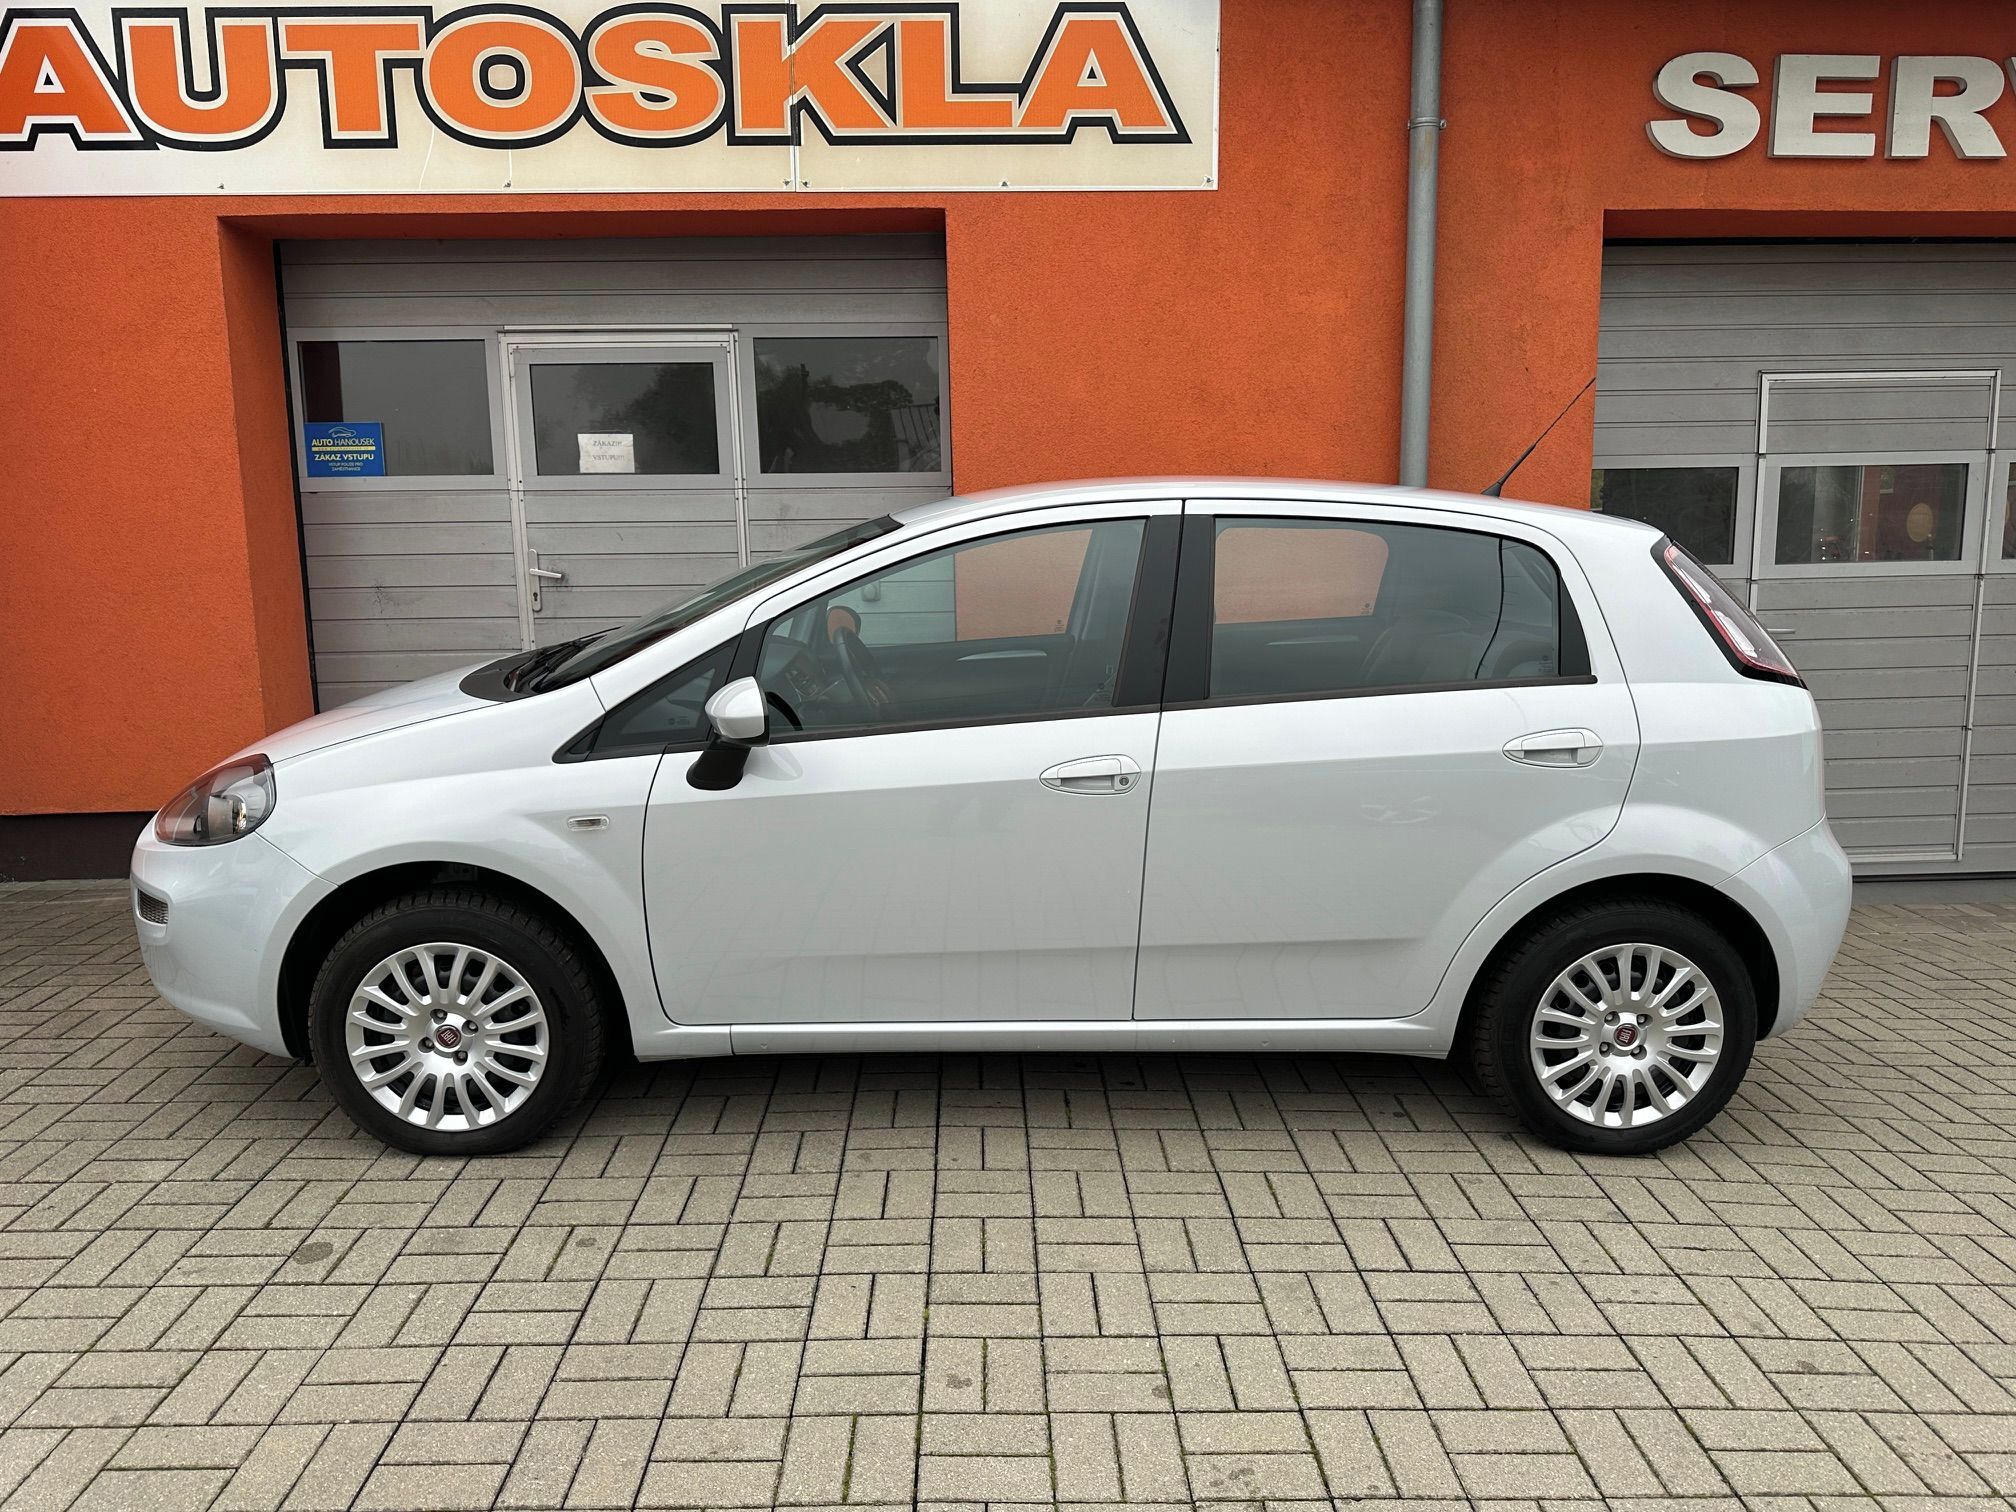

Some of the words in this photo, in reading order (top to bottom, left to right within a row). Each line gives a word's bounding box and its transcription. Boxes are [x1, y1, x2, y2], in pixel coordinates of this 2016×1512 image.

[0, 2, 1193, 151] AUTOSKLA
[1645, 51, 2016, 160] SER
[311, 438, 333, 446] AUTO
[334, 438, 375, 446] HANOUSEK
[314, 453, 341, 461] ZÁKAZ
[440, 1029, 457, 1044] FIAT
[1618, 1028, 1632, 1044] FIAT
